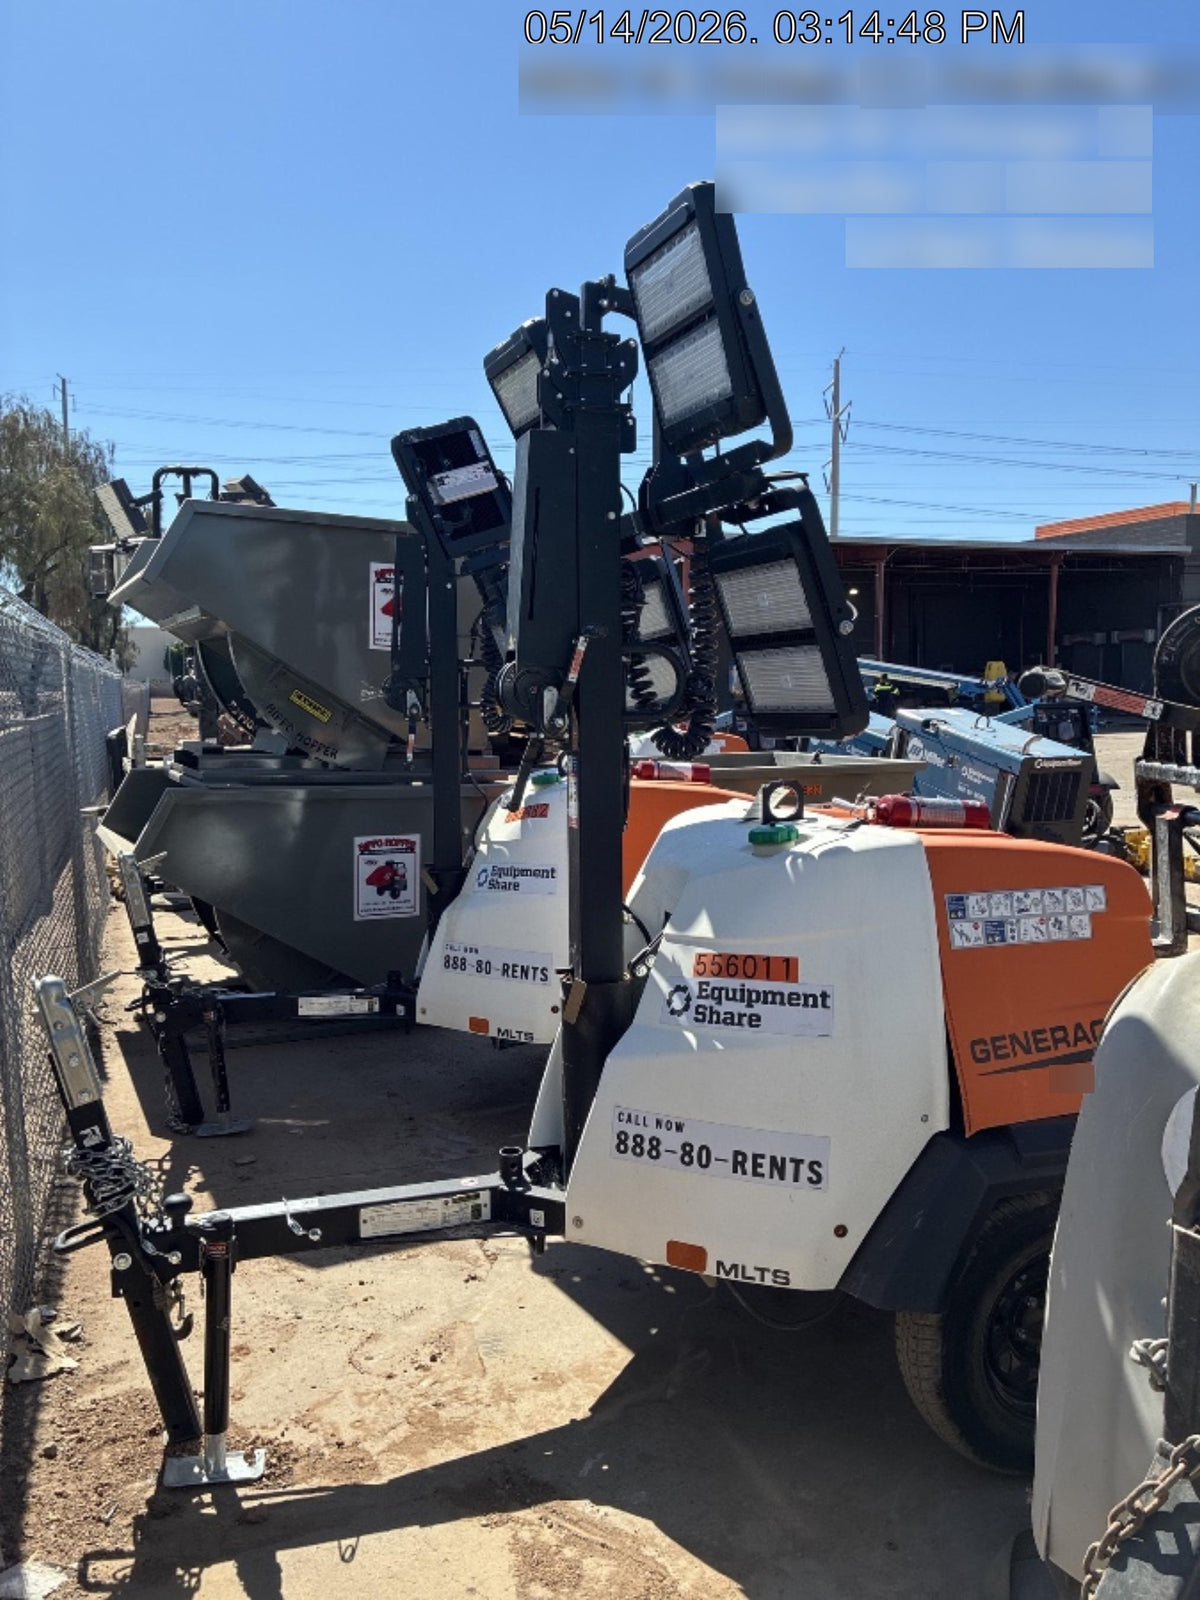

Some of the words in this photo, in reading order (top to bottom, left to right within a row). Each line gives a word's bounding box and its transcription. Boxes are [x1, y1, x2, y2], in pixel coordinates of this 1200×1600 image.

[487, 878, 520, 891] Share
[490, 865, 557, 879] Equipment
[444, 954, 549, 982] 888-80-RENTS
[695, 953, 791, 981] 556011
[696, 980, 831, 1009] Equipment
[693, 1004, 762, 1028] Share
[497, 1027, 534, 1041] MLTS
[617, 1111, 649, 1128] CALL
[655, 1117, 685, 1133] NOW
[615, 1130, 823, 1185] 888-80-RENTS
[716, 1260, 790, 1286] MLTS
